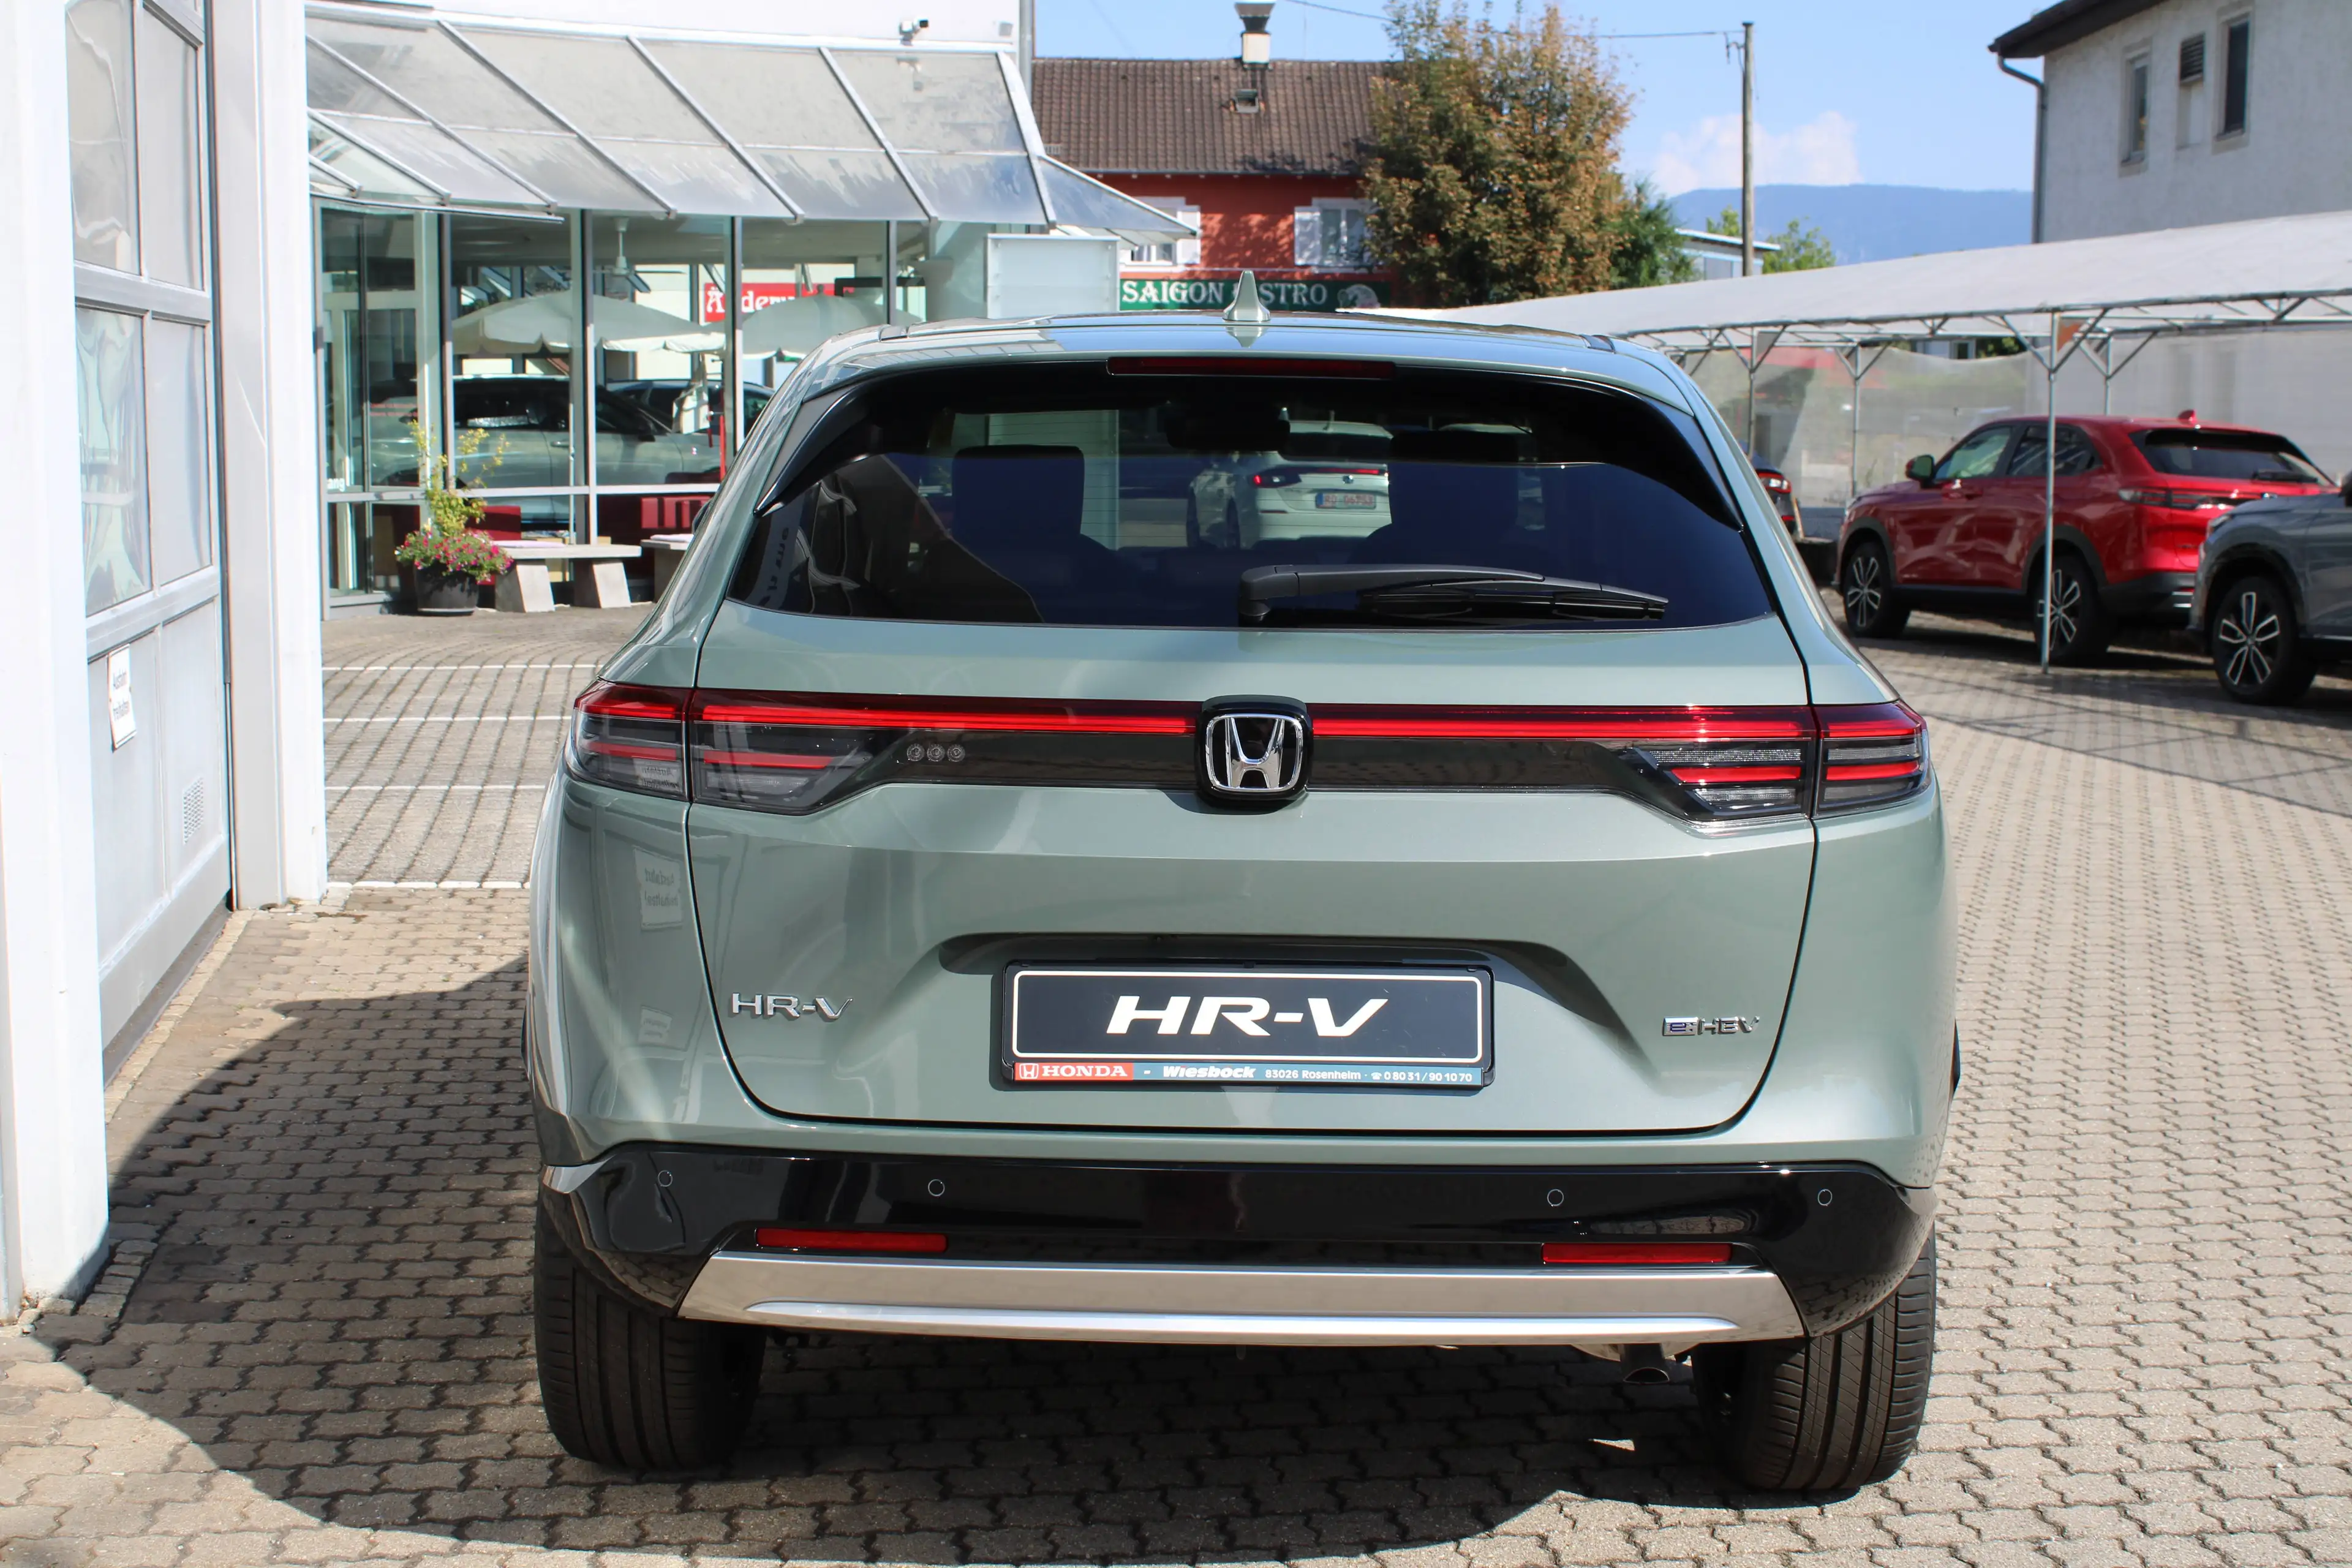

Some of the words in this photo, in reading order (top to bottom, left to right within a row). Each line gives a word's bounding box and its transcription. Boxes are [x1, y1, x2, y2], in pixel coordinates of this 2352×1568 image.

[1122, 281, 1224, 304] SAIGON
[1232, 282, 1328, 305] STRO
[326, 478, 345, 492] ang
[732, 992, 854, 1019] HR-V
[1106, 995, 1389, 1036] HR-V
[1041, 1065, 1128, 1077] HONDA
[1265, 1069, 1298, 1079] 83026
[1302, 1070, 1361, 1079] Rosenheim
